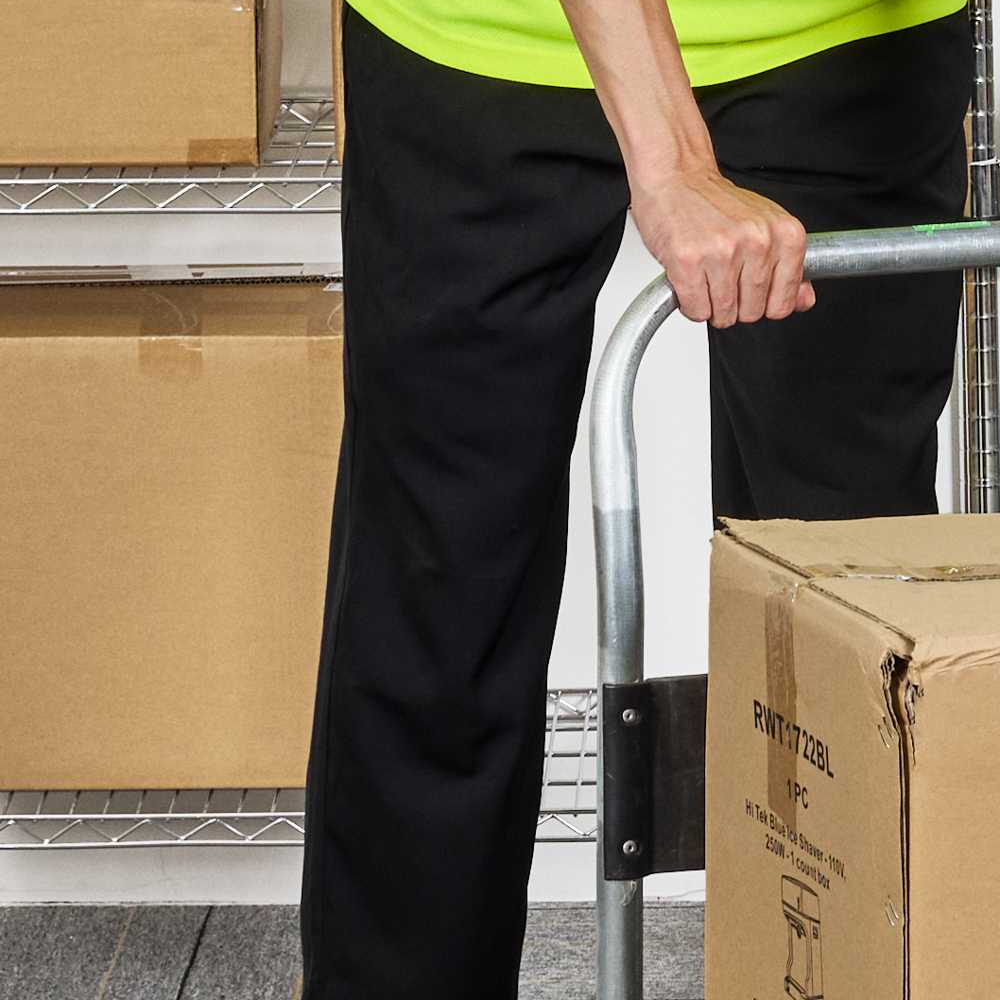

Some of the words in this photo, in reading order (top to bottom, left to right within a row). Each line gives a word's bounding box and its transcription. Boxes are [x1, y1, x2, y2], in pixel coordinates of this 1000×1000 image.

[753, 699, 834, 779] RWT1722BL
[794, 782, 808, 809] PC
[745, 798, 754, 819] Hi
[755, 804, 768, 826] Tek
[799, 832, 824, 863] Shaver
[765, 833, 785, 859] 250W
[796, 858, 817, 882] count
[818, 868, 830, 890] box
